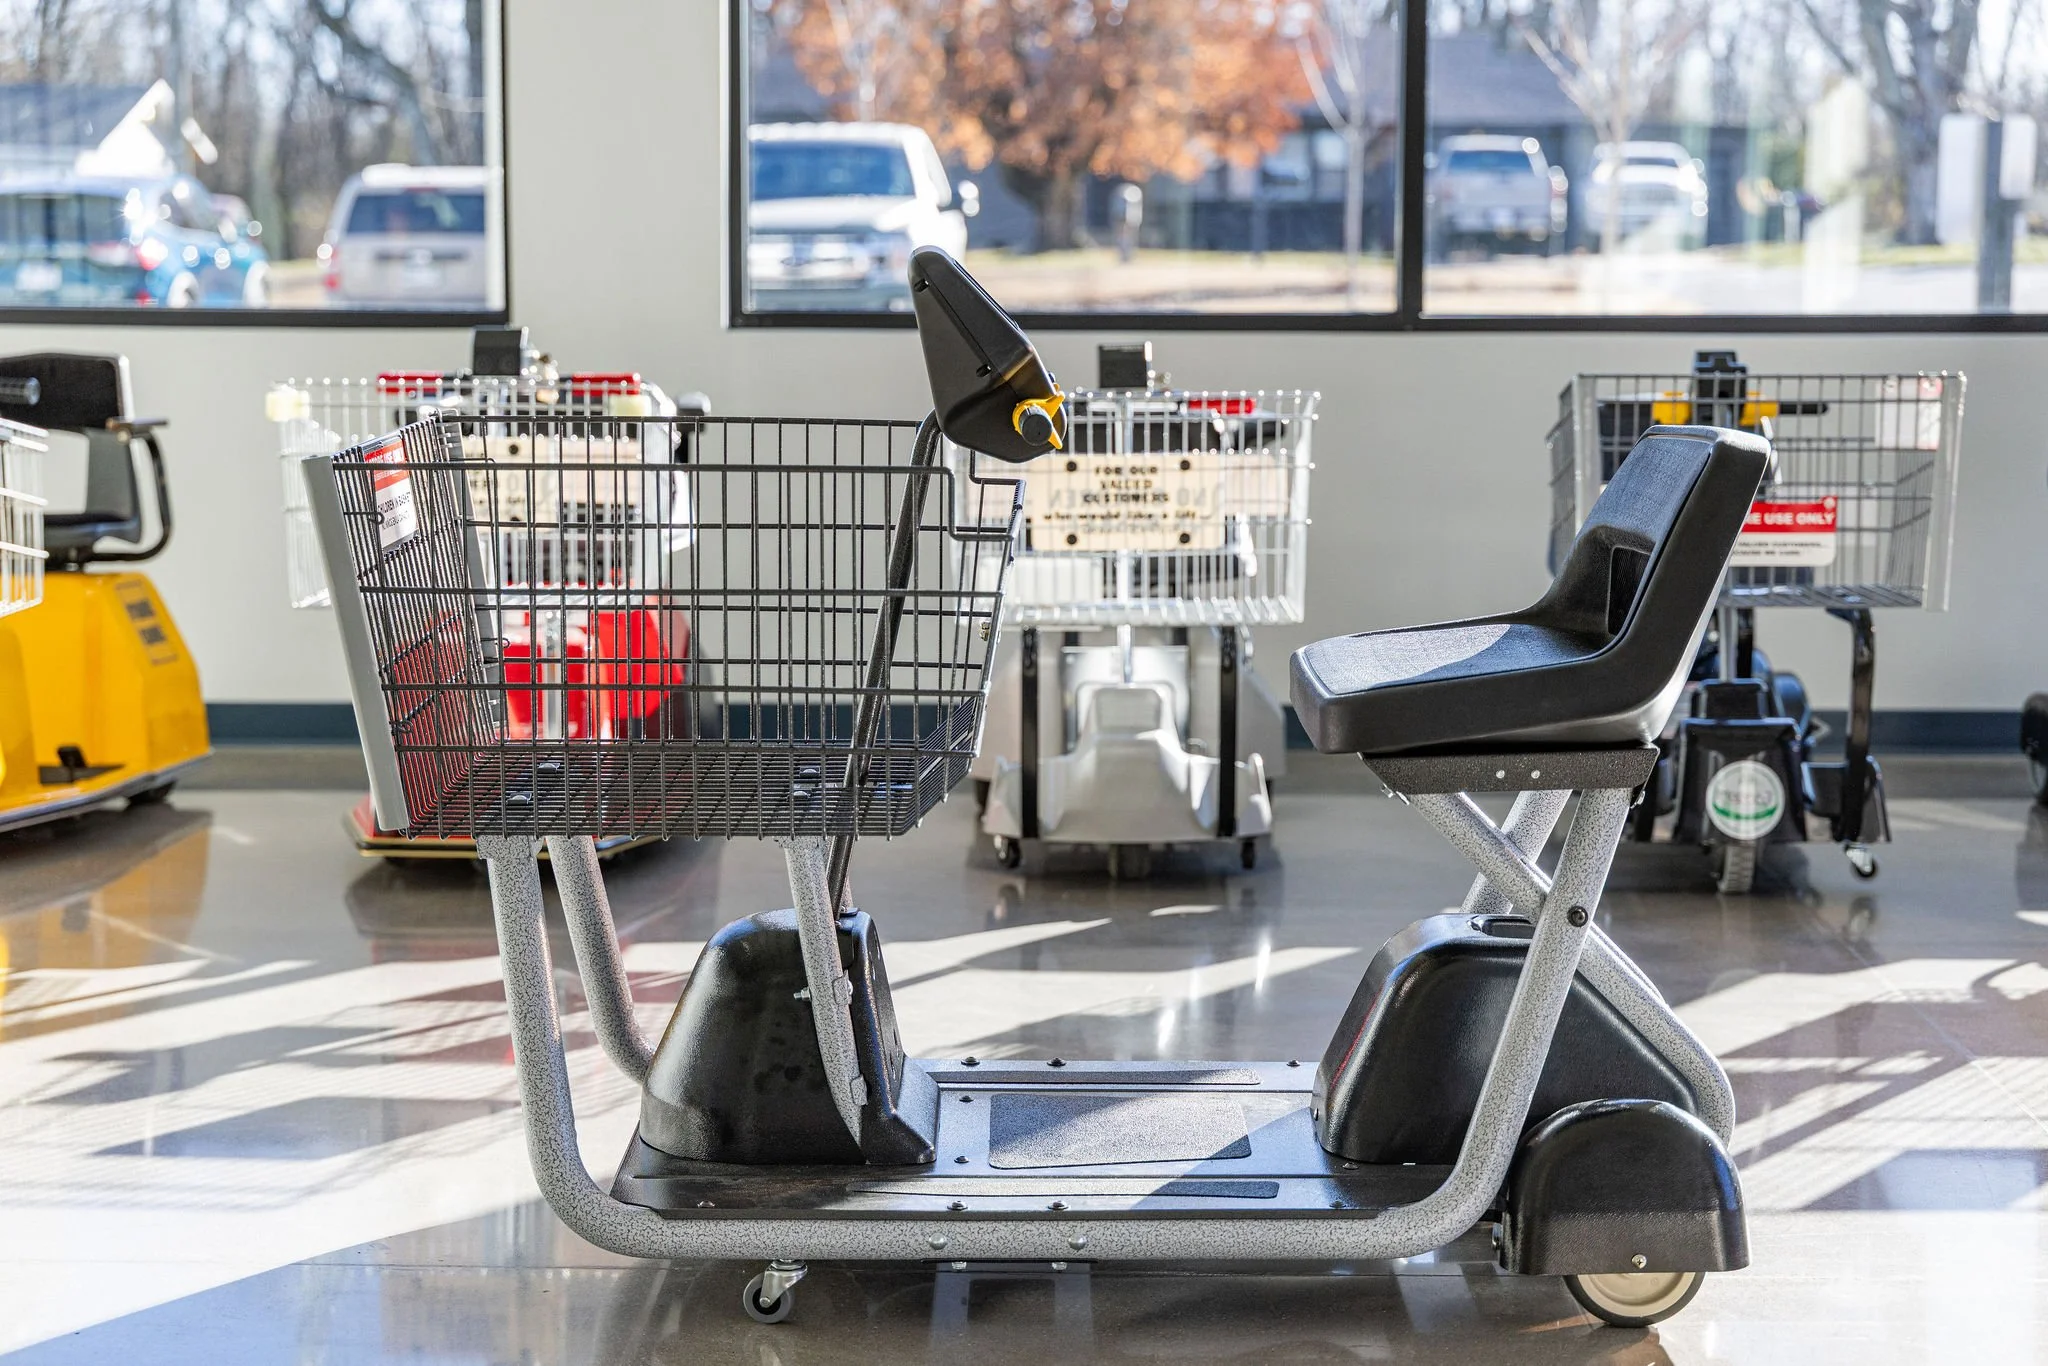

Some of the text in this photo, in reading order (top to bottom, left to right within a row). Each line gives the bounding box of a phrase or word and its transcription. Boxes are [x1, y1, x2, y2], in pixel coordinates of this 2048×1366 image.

[1095, 466, 1122, 475] FOR
[1764, 512, 1793, 525] USE
[1796, 512, 1834, 525] ONLY
